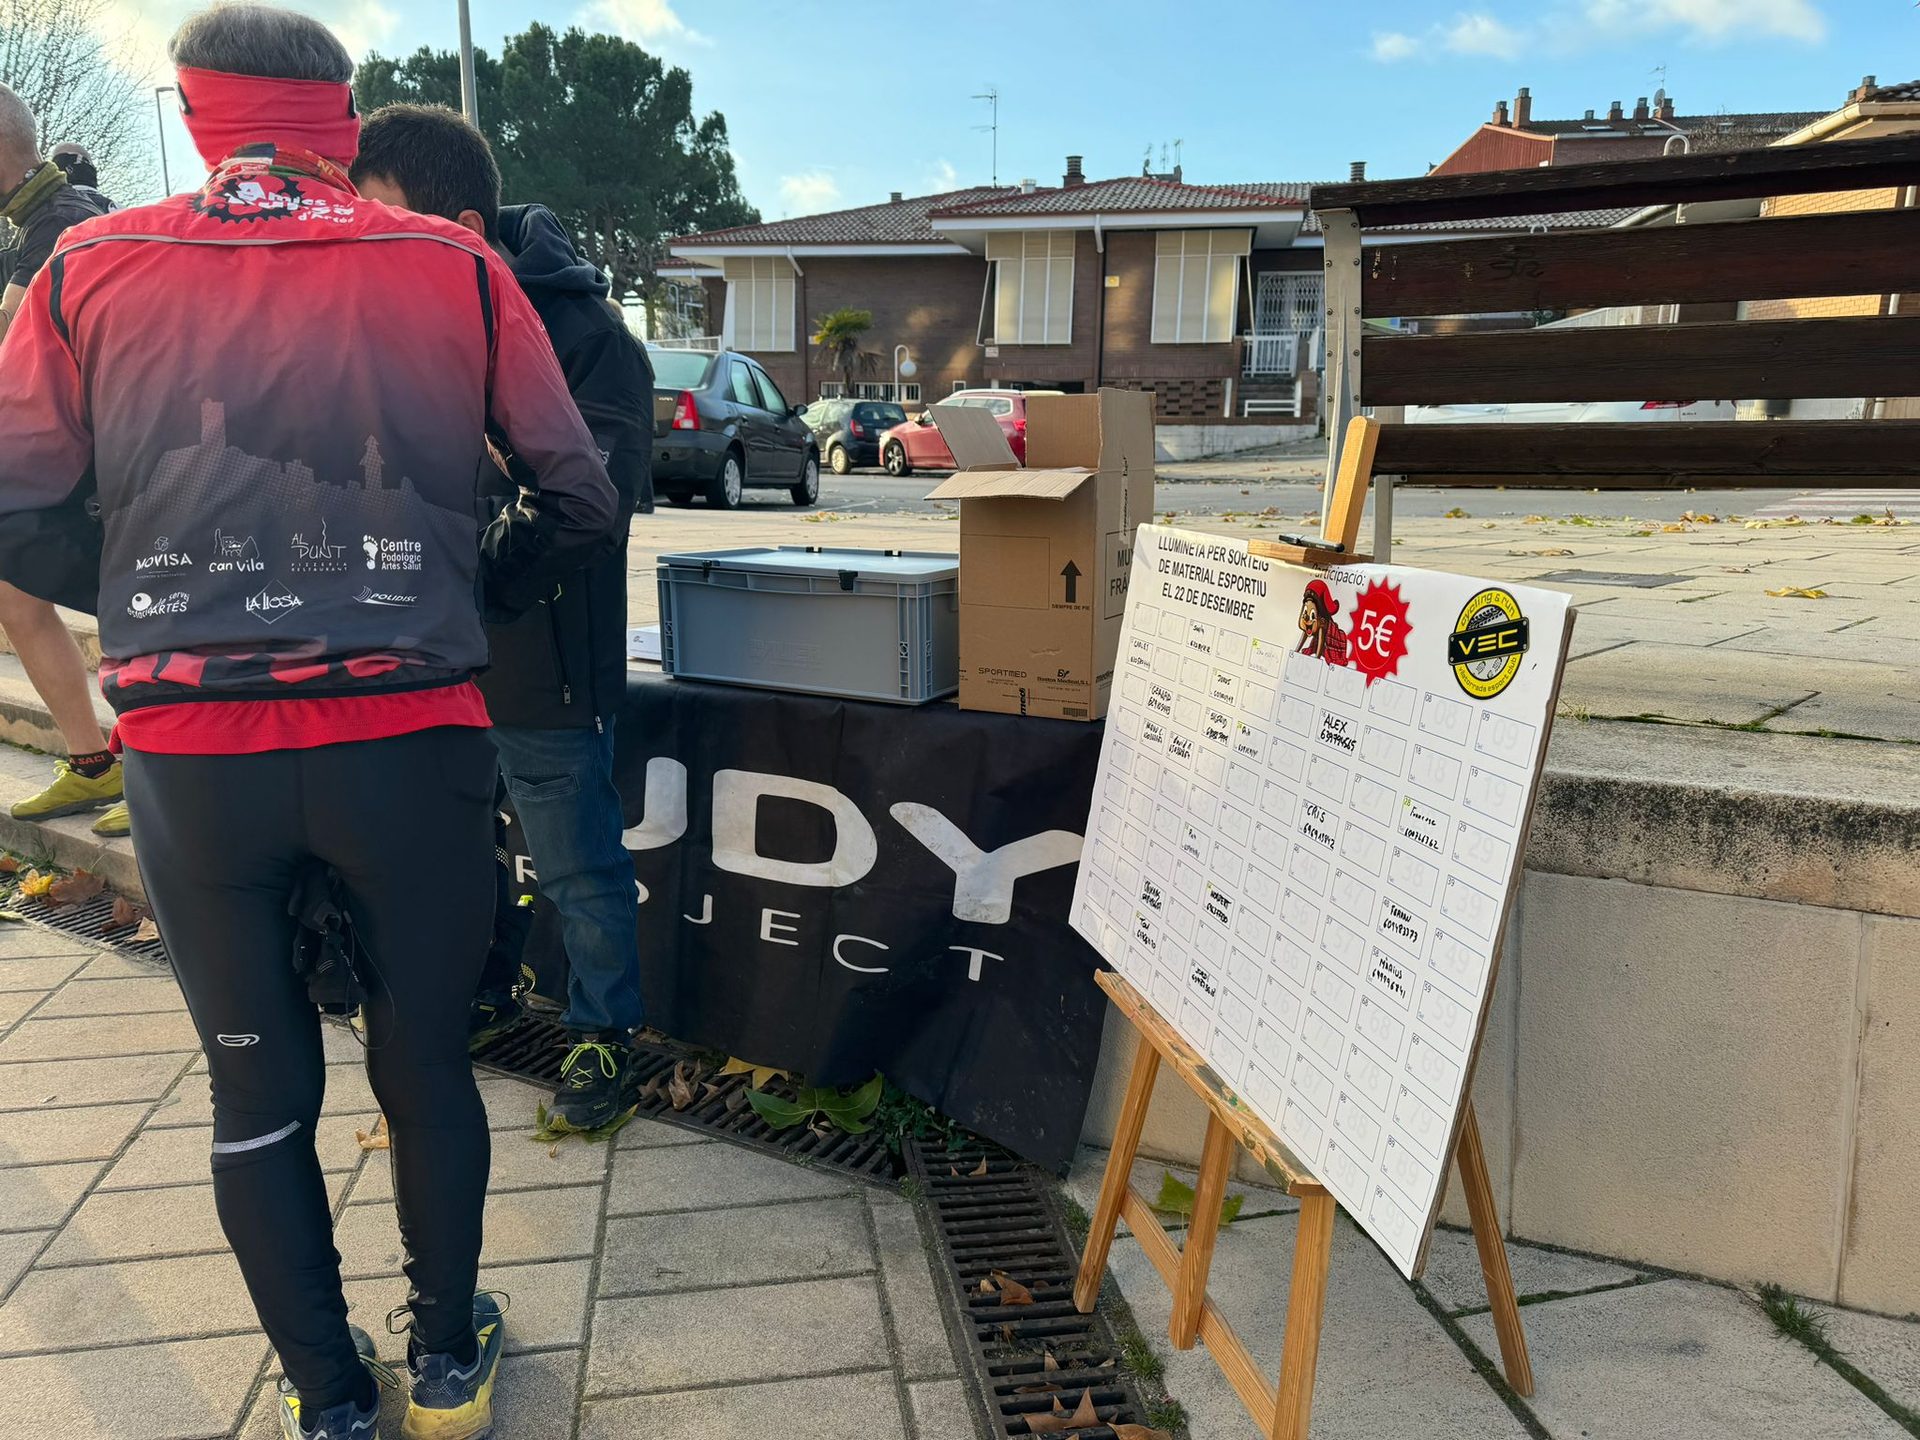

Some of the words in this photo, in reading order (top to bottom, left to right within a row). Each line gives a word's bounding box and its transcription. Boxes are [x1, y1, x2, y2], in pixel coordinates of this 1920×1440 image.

[380, 538, 422, 552] Centre
[1206, 545, 1226, 562] PER
[209, 562, 233, 572] can
[403, 561, 421, 570] Salut
[1110, 572, 1130, 597] FRÁ
[1158, 558, 1169, 574] DE
[1172, 562, 1215, 585] MATERIAL
[1217, 571, 1267, 598] ESPORTIU
[1162, 582, 1173, 598] EL
[1175, 586, 1184, 601] 22
[1186, 588, 1198, 605] DE
[1200, 592, 1255, 621] DESEMBRE
[1501, 596, 1515, 617] run
[1357, 609, 1397, 658] 5€
[1458, 629, 1518, 655] VEC
[1324, 714, 1347, 734] ALEX
